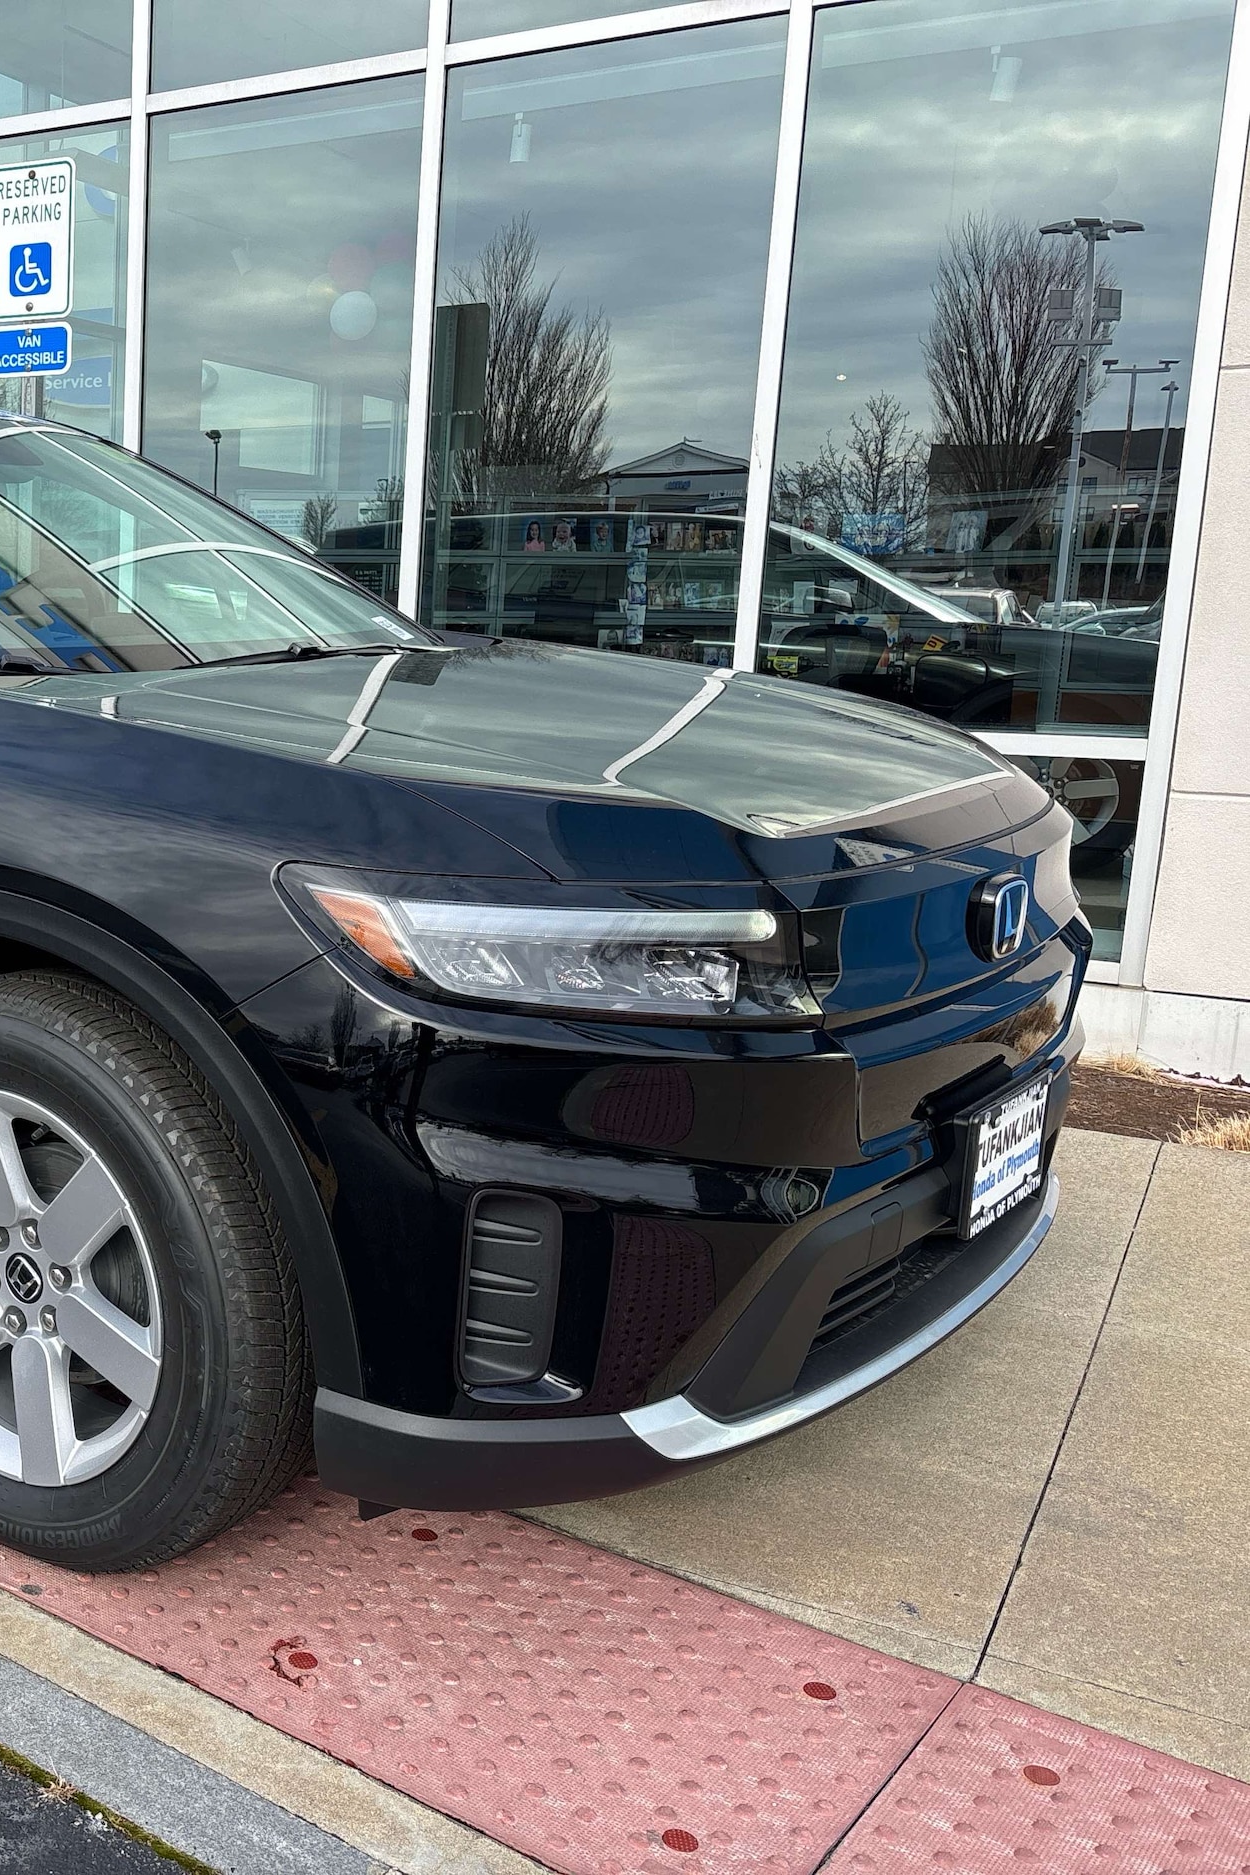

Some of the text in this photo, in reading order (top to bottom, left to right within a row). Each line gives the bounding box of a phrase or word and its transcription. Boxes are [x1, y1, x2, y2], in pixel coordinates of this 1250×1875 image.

[3, 202, 61, 226] PARKING
[17, 335, 41, 348] VAN
[45, 373, 103, 389] Service
[1006, 1138, 1039, 1177] Plymouth
[970, 1174, 1041, 1239] HONDA OF PLYMOUTH
